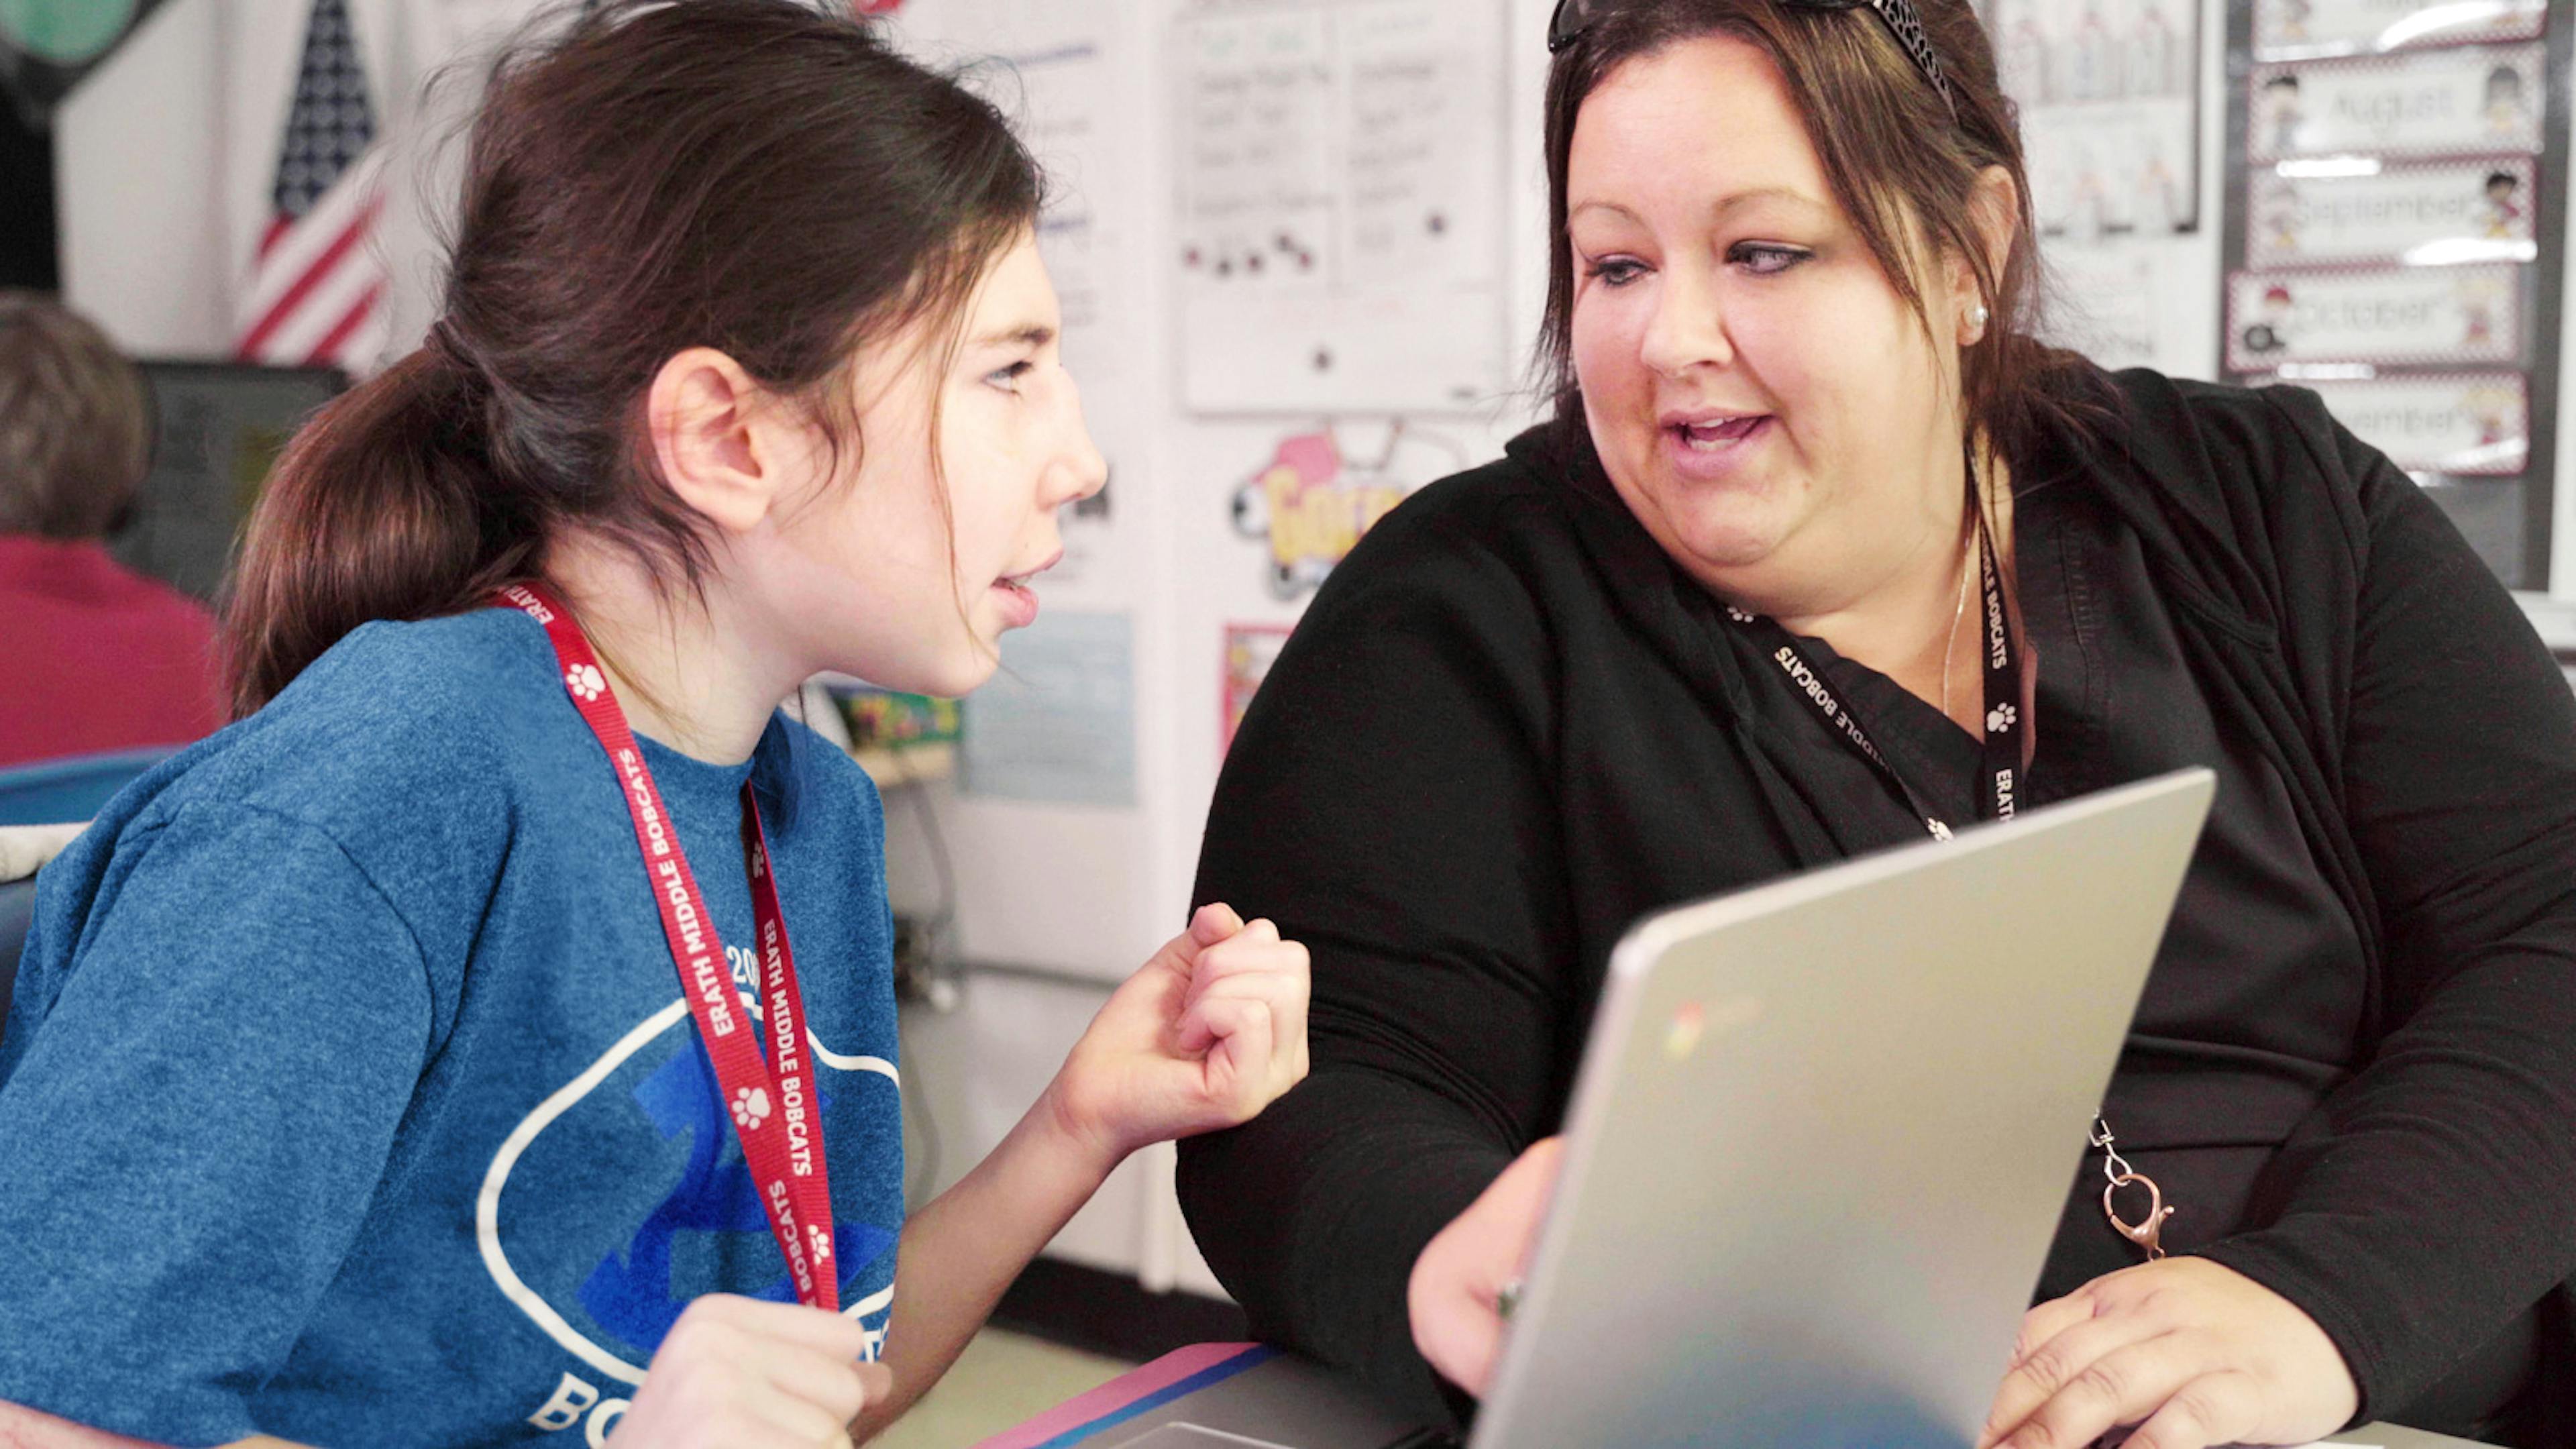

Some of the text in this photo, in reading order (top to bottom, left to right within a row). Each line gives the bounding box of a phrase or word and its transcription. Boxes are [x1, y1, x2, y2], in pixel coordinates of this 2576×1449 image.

[1774, 646, 1838, 717] BOBCATS
[1988, 590, 2007, 669] BOBCATS
[619, 748, 735, 1038] ERATH MIDDLE BOBCATS
[763, 918, 813, 1177] ERATH MIDDLE BOBCATS
[768, 1179, 812, 1293] BOBCATS
